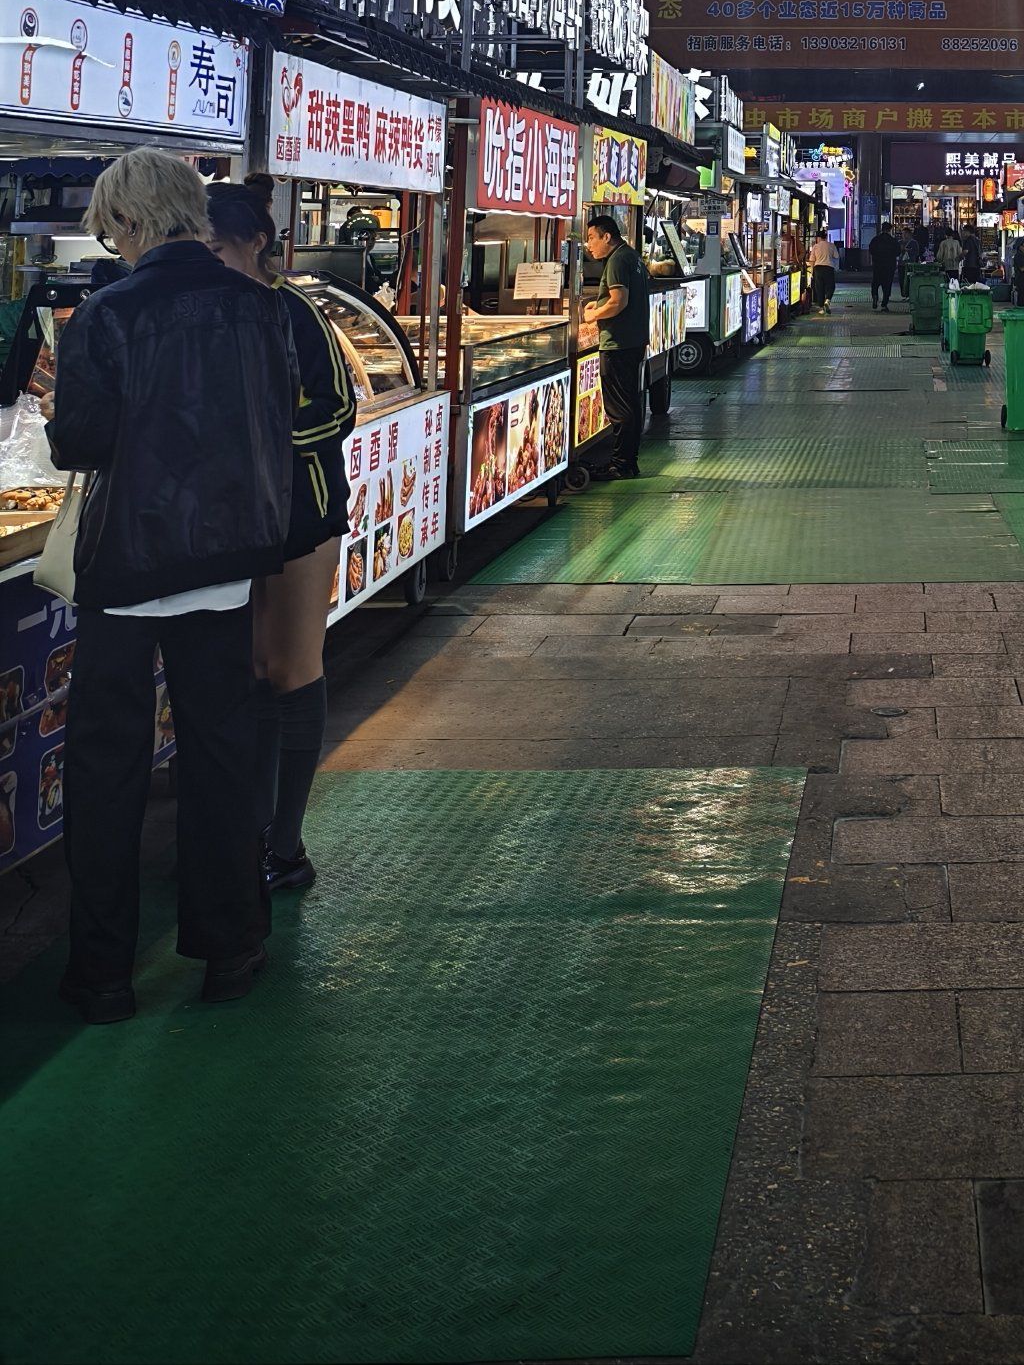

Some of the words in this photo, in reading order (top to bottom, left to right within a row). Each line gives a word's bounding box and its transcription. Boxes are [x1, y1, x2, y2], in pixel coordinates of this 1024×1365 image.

[706, 0, 948, 20] 40多个业态近15万种商品
[800, 36, 908, 51] 13903216131
[941, 37, 1019, 52] 88252096
[189, 40, 237, 126] 寿司
[275, 134, 301, 162] 卤香源
[307, 89, 370, 163] 甜辣黑鸭
[373, 106, 425, 171] 麻辣鸭货
[484, 106, 577, 210] 吮指小海鲜
[349, 420, 399, 482] 卤香源
[420, 408, 433, 549] 秘制传承
[430, 402, 444, 541] 卤香百年
